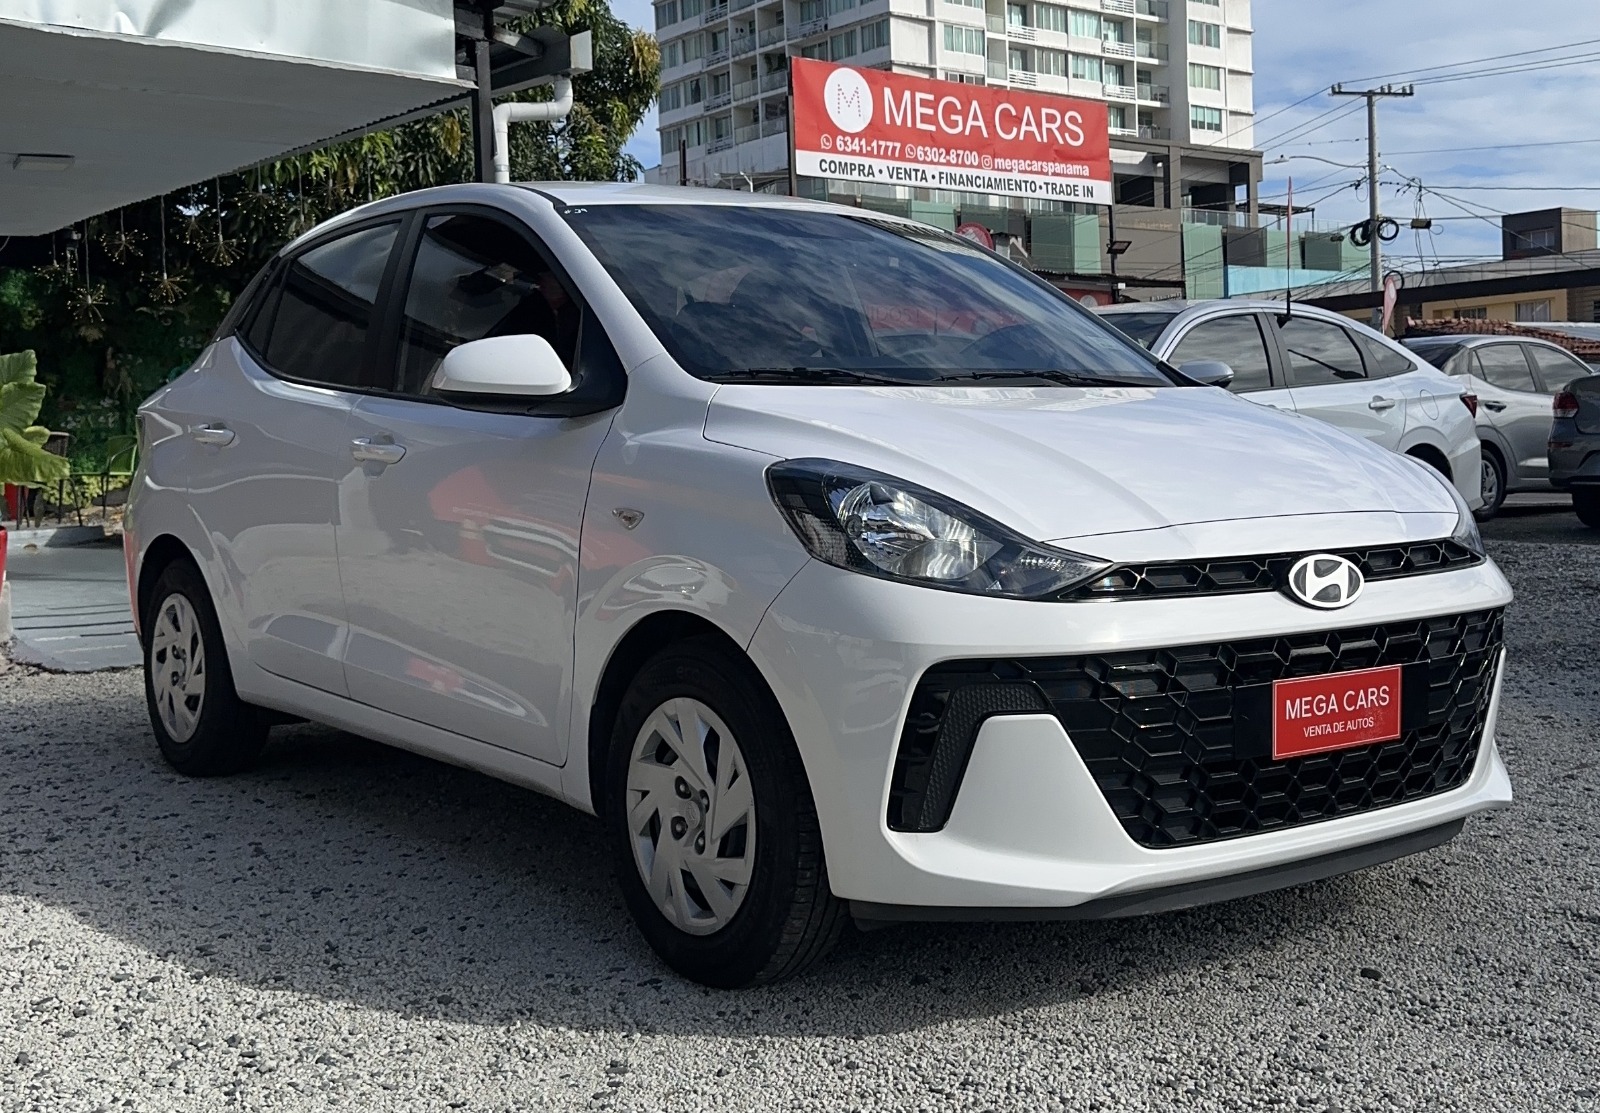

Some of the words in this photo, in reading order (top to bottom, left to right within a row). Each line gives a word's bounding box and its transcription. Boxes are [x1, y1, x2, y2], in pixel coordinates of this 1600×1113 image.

[883, 86, 989, 138] MEGA
[994, 102, 1085, 147] CARS
[835, 135, 902, 158] 6341-1777
[917, 145, 979, 166] 6302-8700
[994, 157, 1090, 177] megacarspanama
[819, 158, 876, 178] COMPRA
[886, 165, 929, 183] VENTA
[938, 171, 1037, 194] FINANCIAMIENTO
[1043, 181, 1080, 197] TRADE
[1082, 185, 1094, 198] IN
[1285, 693, 1339, 720] MEGA
[1343, 685, 1390, 711] CARS
[1303, 723, 1332, 738] VENTA
[1333, 721, 1345, 733] DE
[1346, 716, 1374, 731] AUTOS
